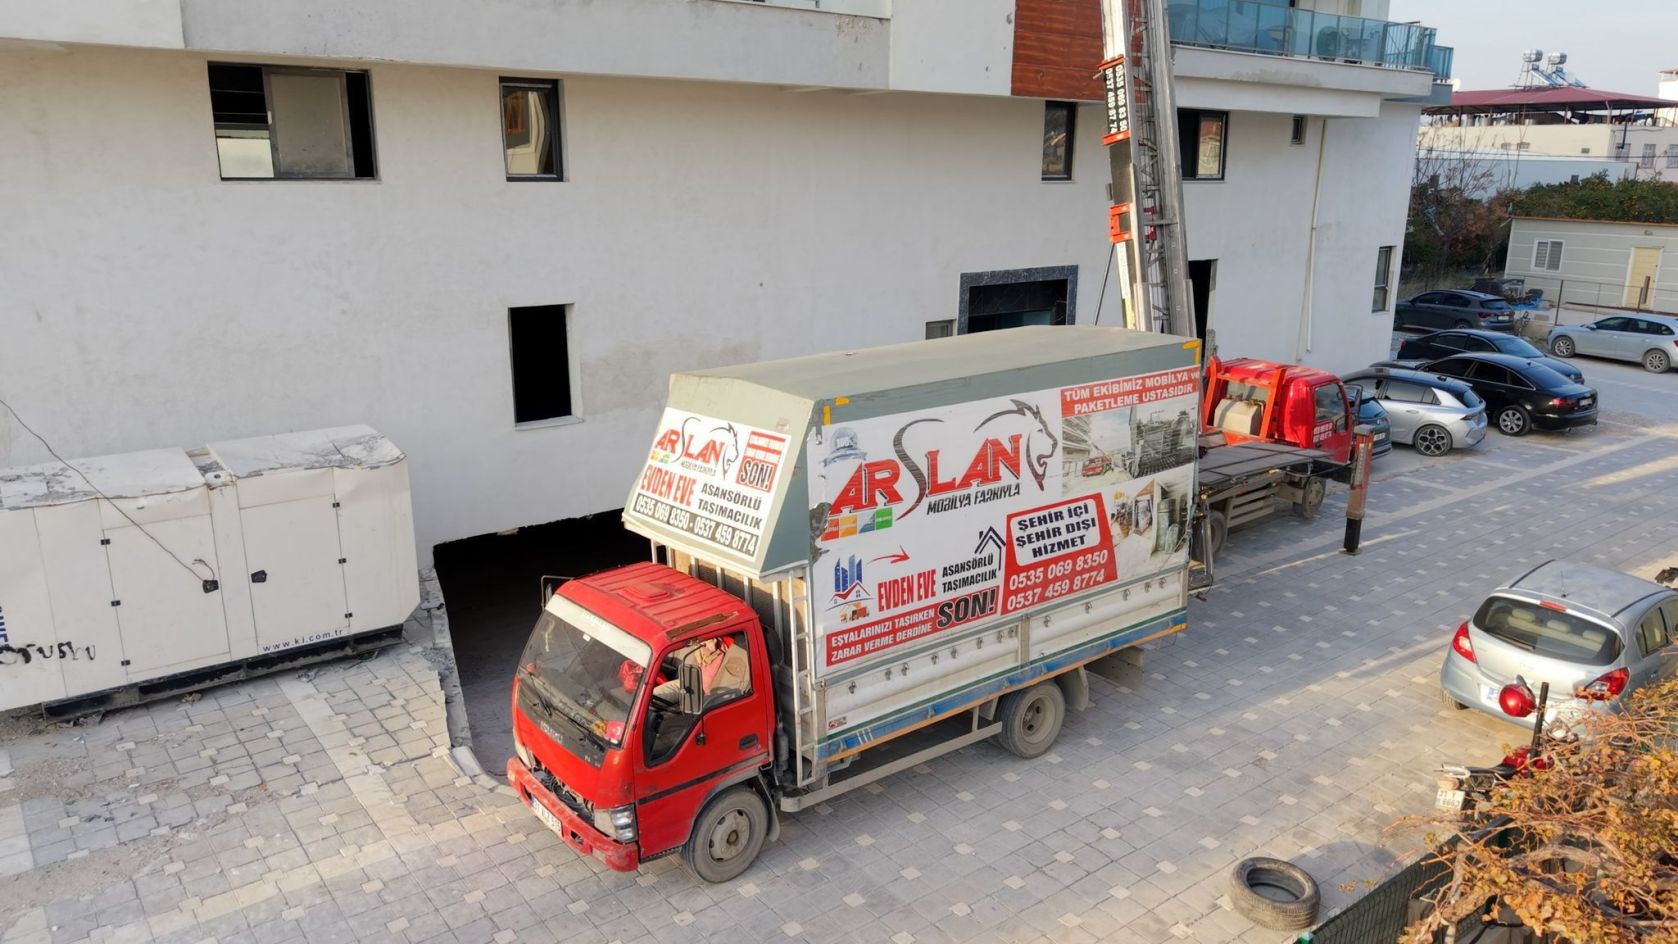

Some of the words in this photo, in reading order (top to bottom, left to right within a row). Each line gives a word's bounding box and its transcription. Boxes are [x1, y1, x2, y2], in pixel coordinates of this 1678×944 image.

[1064, 388, 1090, 402] TÜM
[1093, 380, 1143, 397] EKİBİMİZ
[1145, 371, 1188, 388] MOBİLYA
[1074, 396, 1139, 415] PAKETLEME
[1142, 383, 1193, 402] USTASIDIR
[655, 417, 726, 466] ARSLAN
[641, 463, 676, 500] EVDEN
[673, 471, 697, 508] EVE
[740, 459, 774, 490] SON!
[829, 417, 1023, 521] ARSLAN
[701, 482, 762, 511] ASANSÖRLÜ
[926, 492, 973, 515] MOBİLYA
[974, 483, 1021, 505] FARKIYLA
[635, 495, 655, 515] 0535
[655, 501, 670, 521] 069
[669, 505, 690, 530] 8350
[694, 513, 715, 538] 0537
[715, 522, 732, 546] 459
[732, 530, 757, 554] 8774
[1015, 526, 1062, 548] ŞEHİR
[1066, 517, 1097, 536] DIŞI
[1017, 510, 1064, 532] ŞEHİR
[1067, 502, 1090, 520] İÇİ
[1032, 534, 1087, 558] HİZMET
[942, 553, 994, 578] ASANSÖRLÜ
[942, 568, 998, 593] TAŞIMACILIK
[1009, 569, 1044, 590] 0535
[1047, 560, 1073, 580] 069
[1075, 549, 1108, 571] 8350
[876, 574, 914, 613] EVDEN
[917, 568, 937, 602] EVE
[1007, 588, 1040, 611] 0537
[1045, 579, 1070, 598] 459
[1073, 569, 1105, 590] 8774
[936, 588, 997, 629] SON!
[831, 622, 892, 648] EŞYALARINIZI
[894, 608, 935, 628] TAŞIRKEN
[831, 644, 862, 662] ZARAR
[864, 636, 894, 652] VERME
[896, 623, 933, 642] DERDİNE
